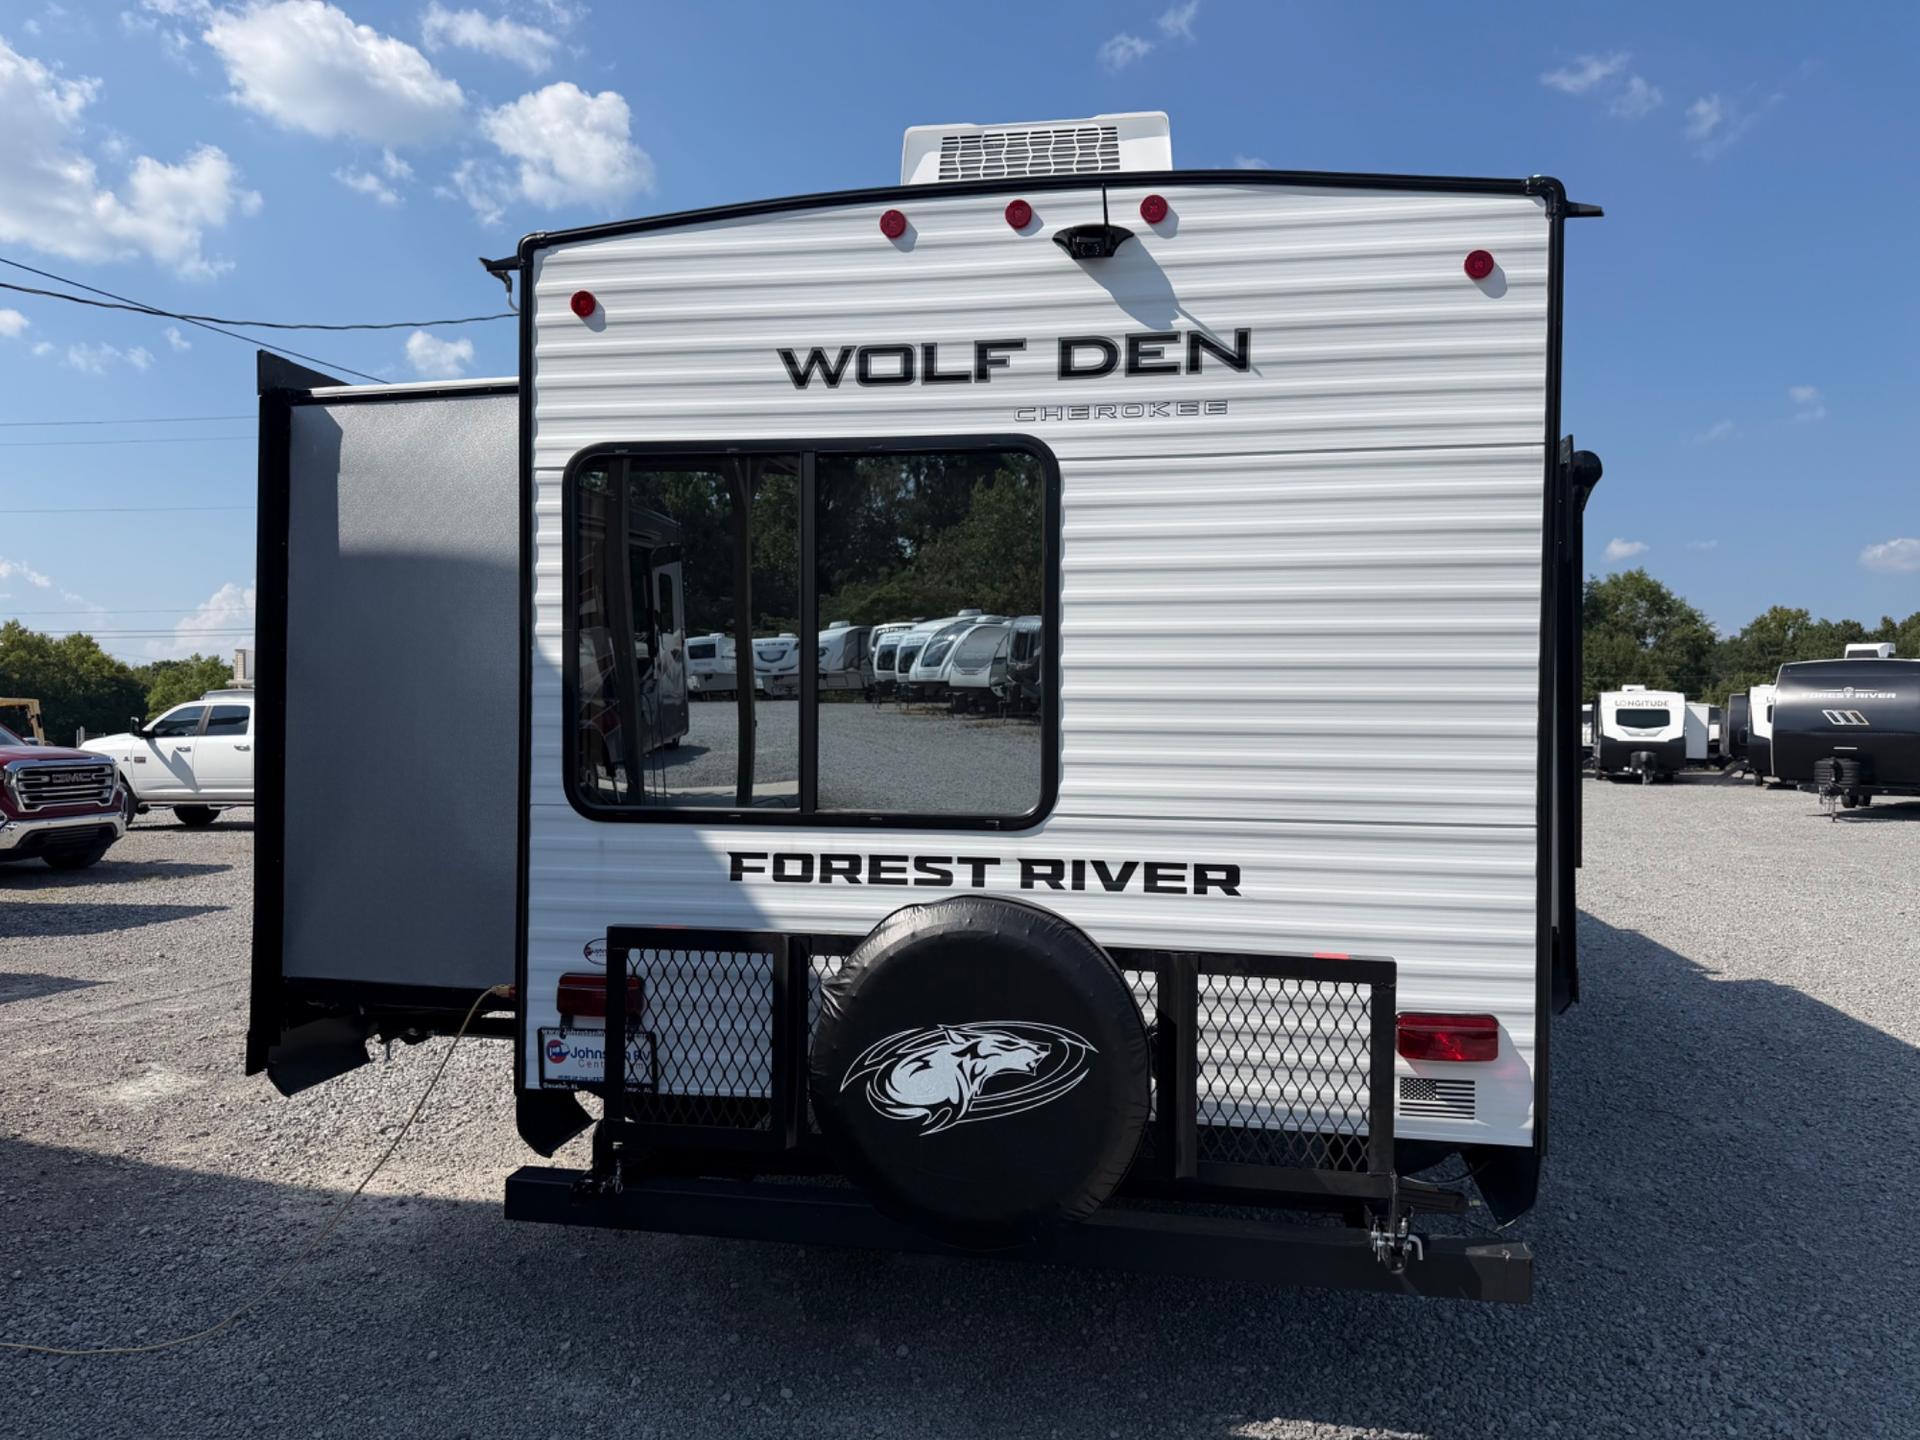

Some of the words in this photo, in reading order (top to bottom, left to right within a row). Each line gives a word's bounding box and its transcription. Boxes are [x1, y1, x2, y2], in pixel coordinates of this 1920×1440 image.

[775, 338, 1028, 390] WOLF
[1057, 327, 1253, 381] DEN
[1012, 400, 1230, 422] CHEROKEE
[1614, 699, 1670, 707] LONGITUDE
[51, 772, 93, 784] GMC
[726, 851, 1001, 888] FOREST
[1016, 857, 1243, 897] RIVER
